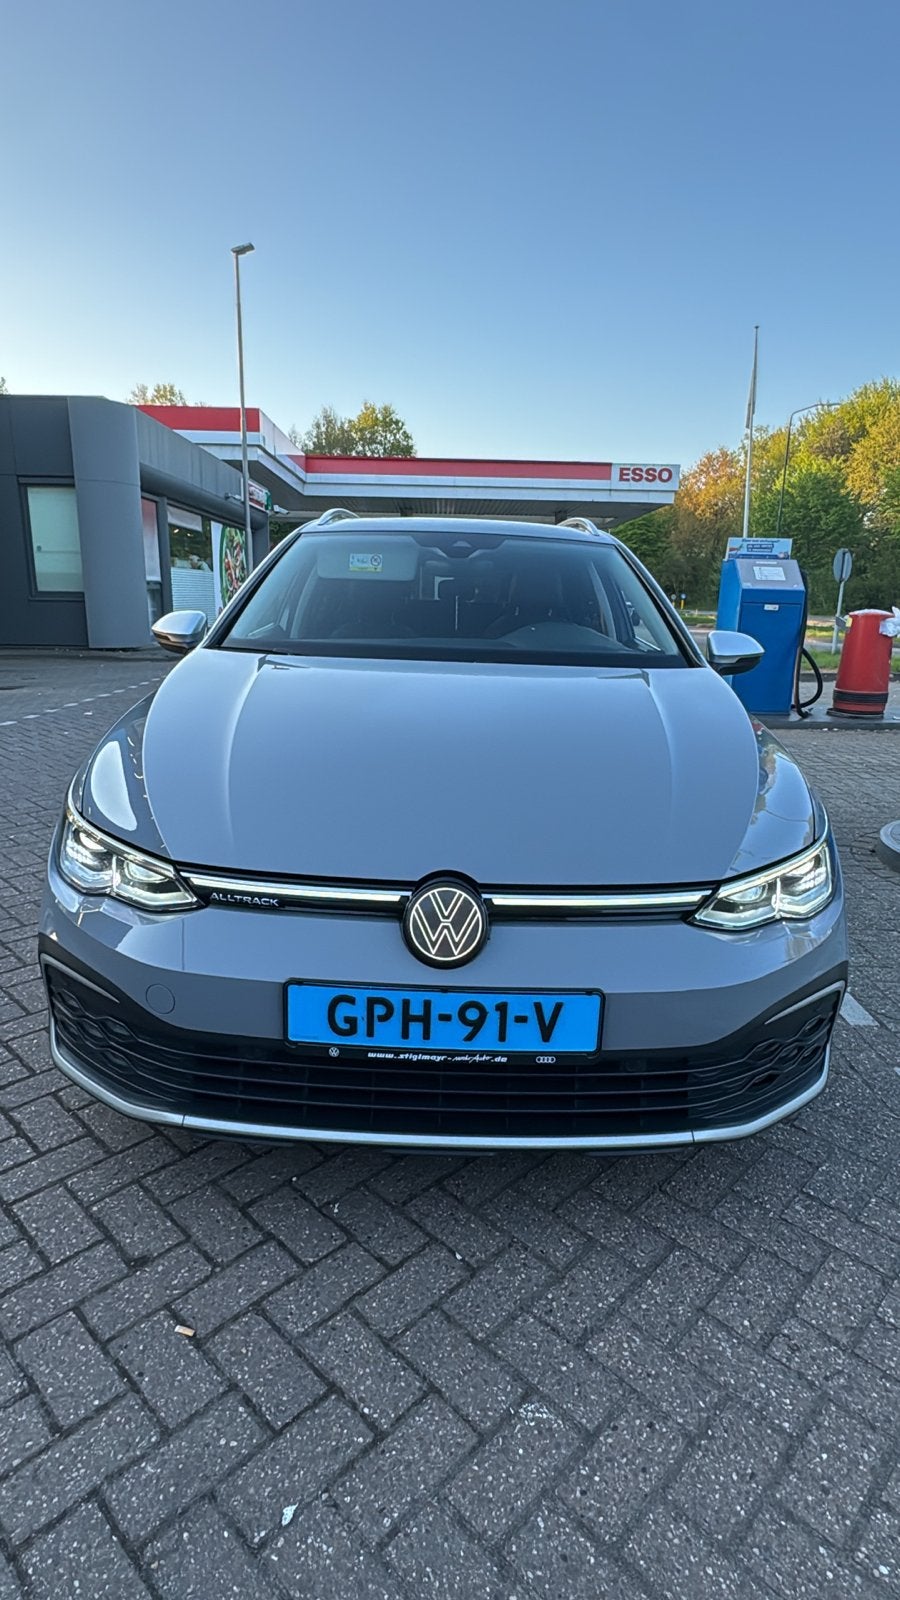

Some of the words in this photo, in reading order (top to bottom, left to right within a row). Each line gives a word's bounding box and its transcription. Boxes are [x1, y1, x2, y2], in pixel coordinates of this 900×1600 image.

[618, 467, 673, 482] ESSO
[209, 892, 279, 907] ALLTRACK
[327, 994, 564, 1042] GPH-91-V
